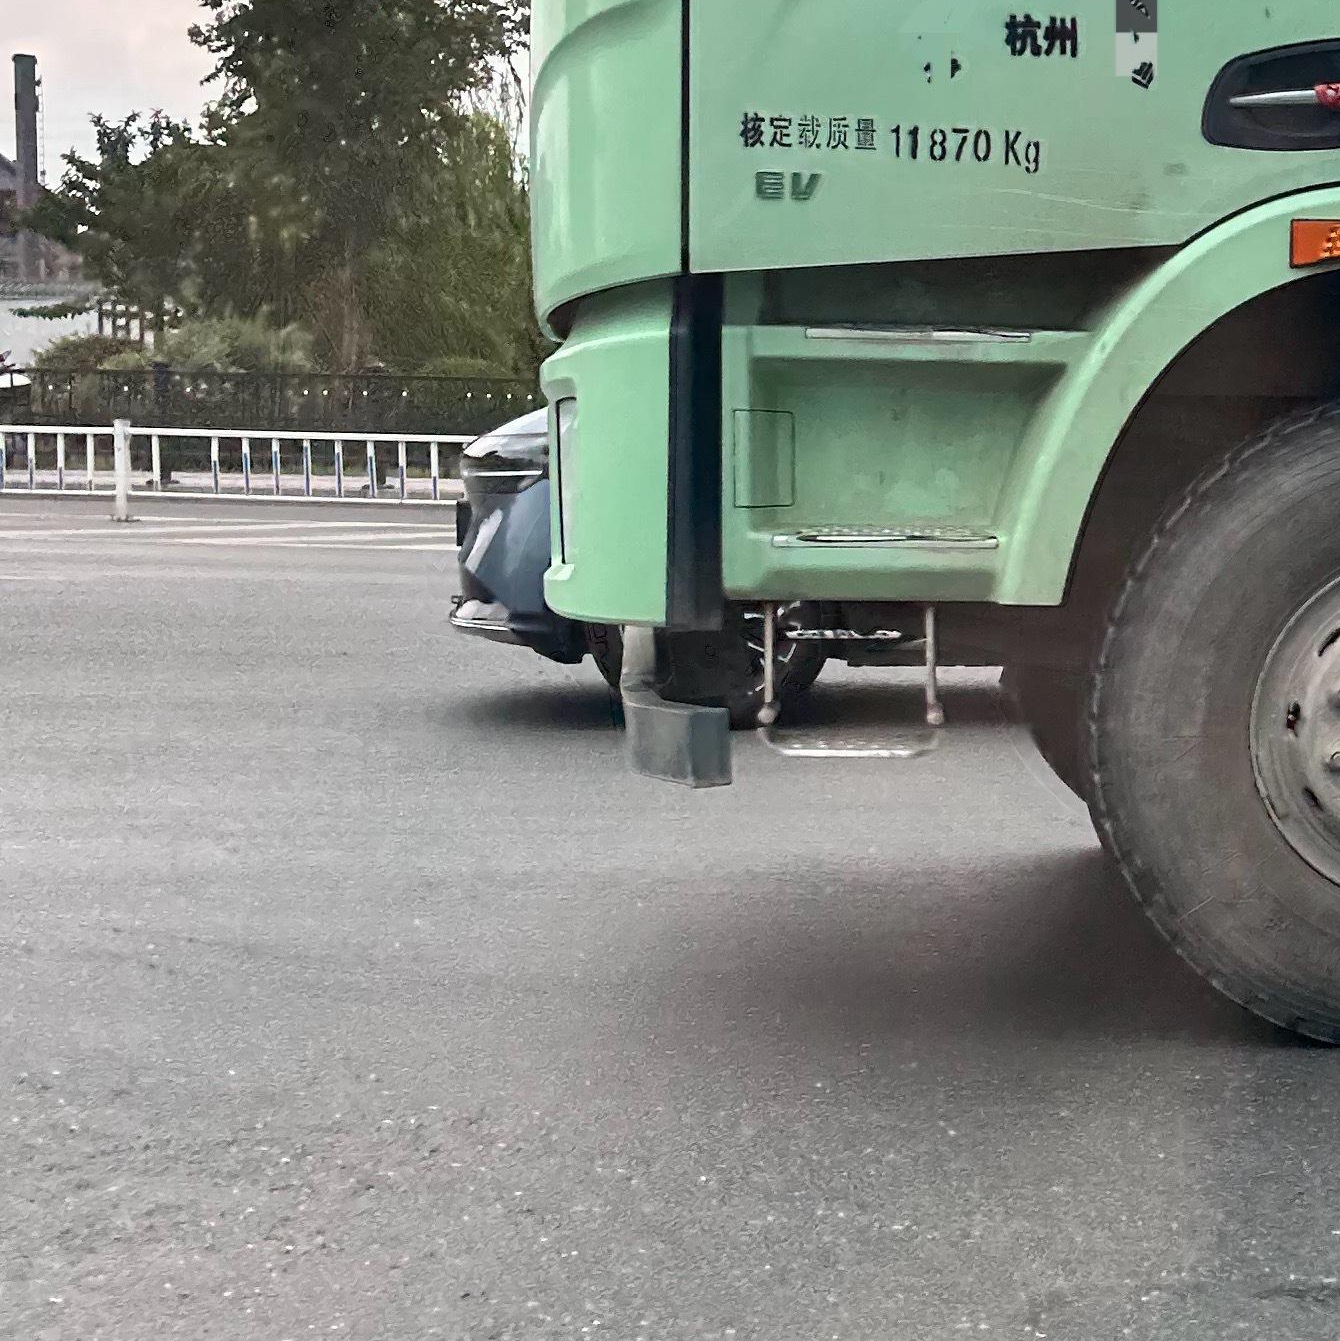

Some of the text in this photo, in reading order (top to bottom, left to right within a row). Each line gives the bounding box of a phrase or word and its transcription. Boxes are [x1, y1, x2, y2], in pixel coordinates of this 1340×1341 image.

[1004, 13, 1079, 58] 杭州
[740, 112, 877, 151] 核定载质量
